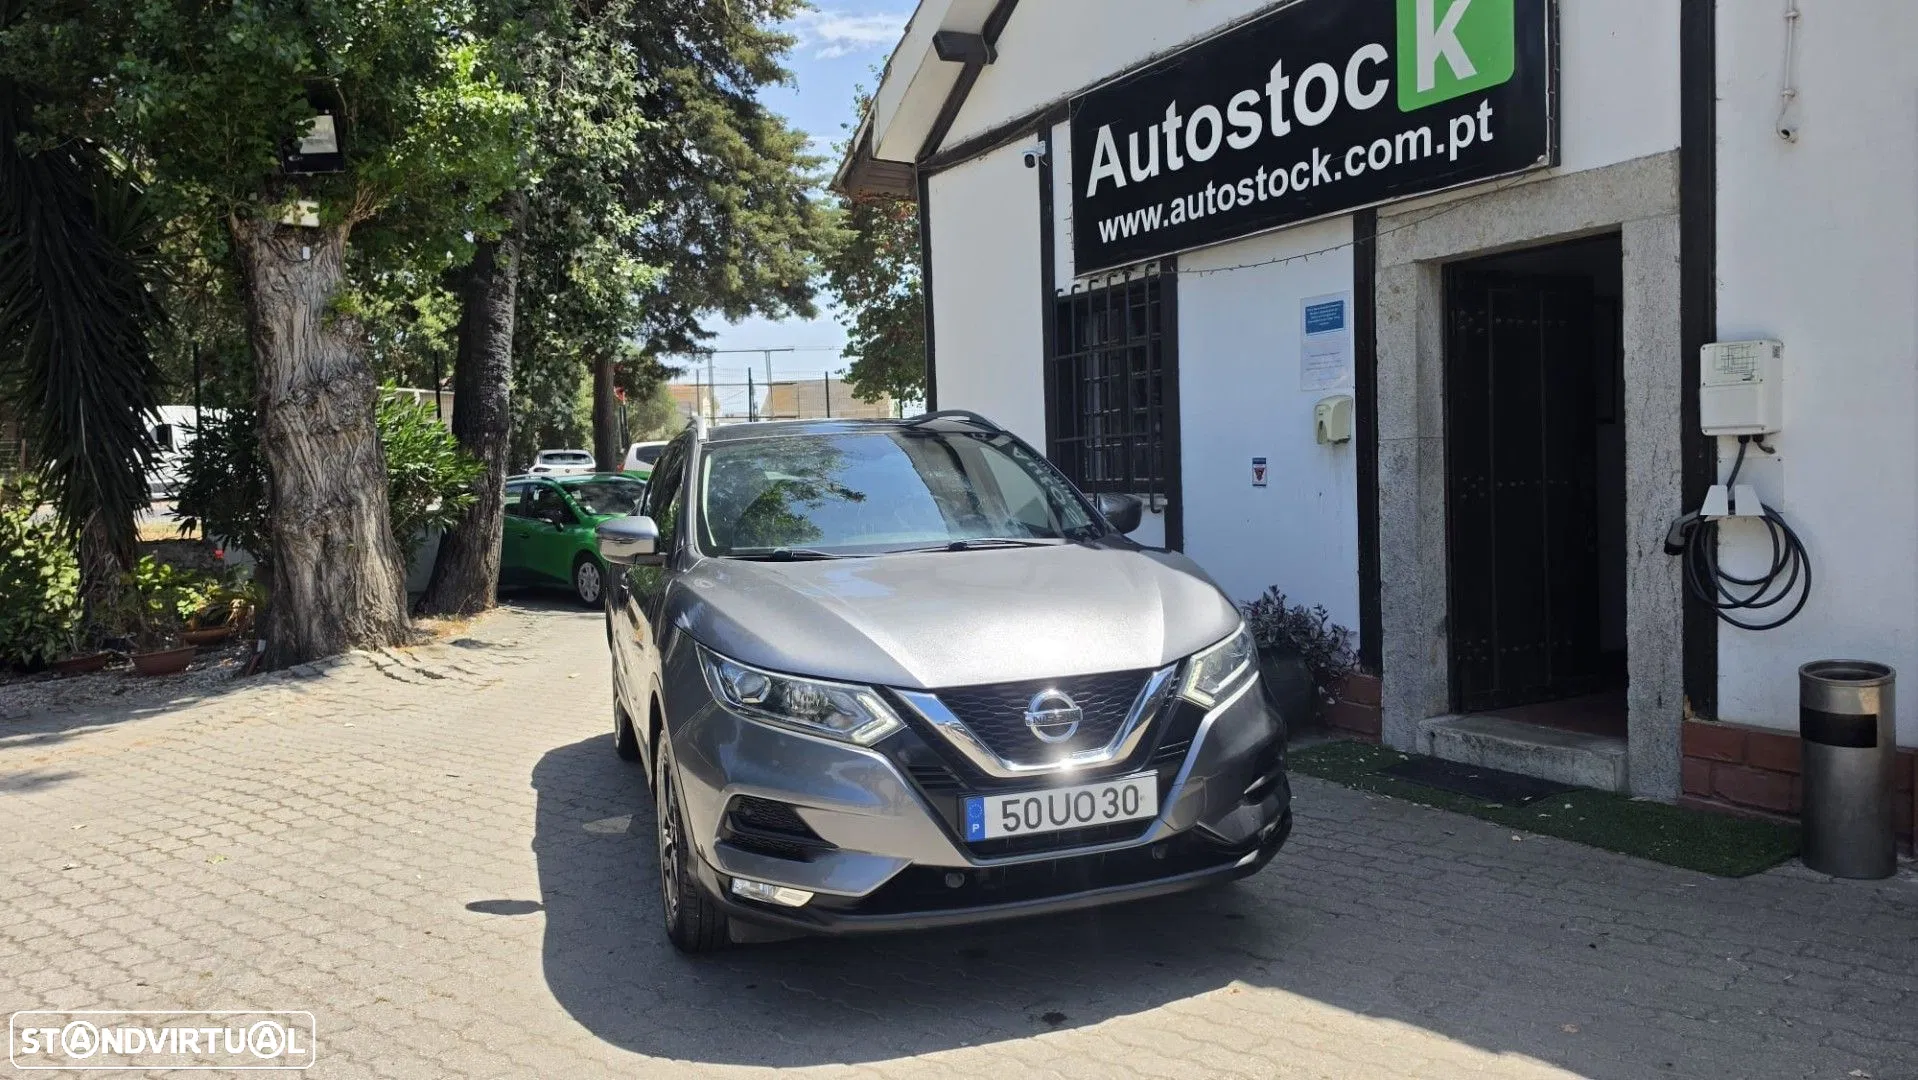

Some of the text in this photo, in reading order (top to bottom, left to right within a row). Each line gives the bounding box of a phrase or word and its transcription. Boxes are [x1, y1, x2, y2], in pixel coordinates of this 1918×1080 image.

[1086, 0, 1478, 198] Autostock
[1098, 99, 1494, 244] www.autostock.com.pt
[972, 823, 980, 834] P
[1001, 784, 1139, 832] 50 UO 30
